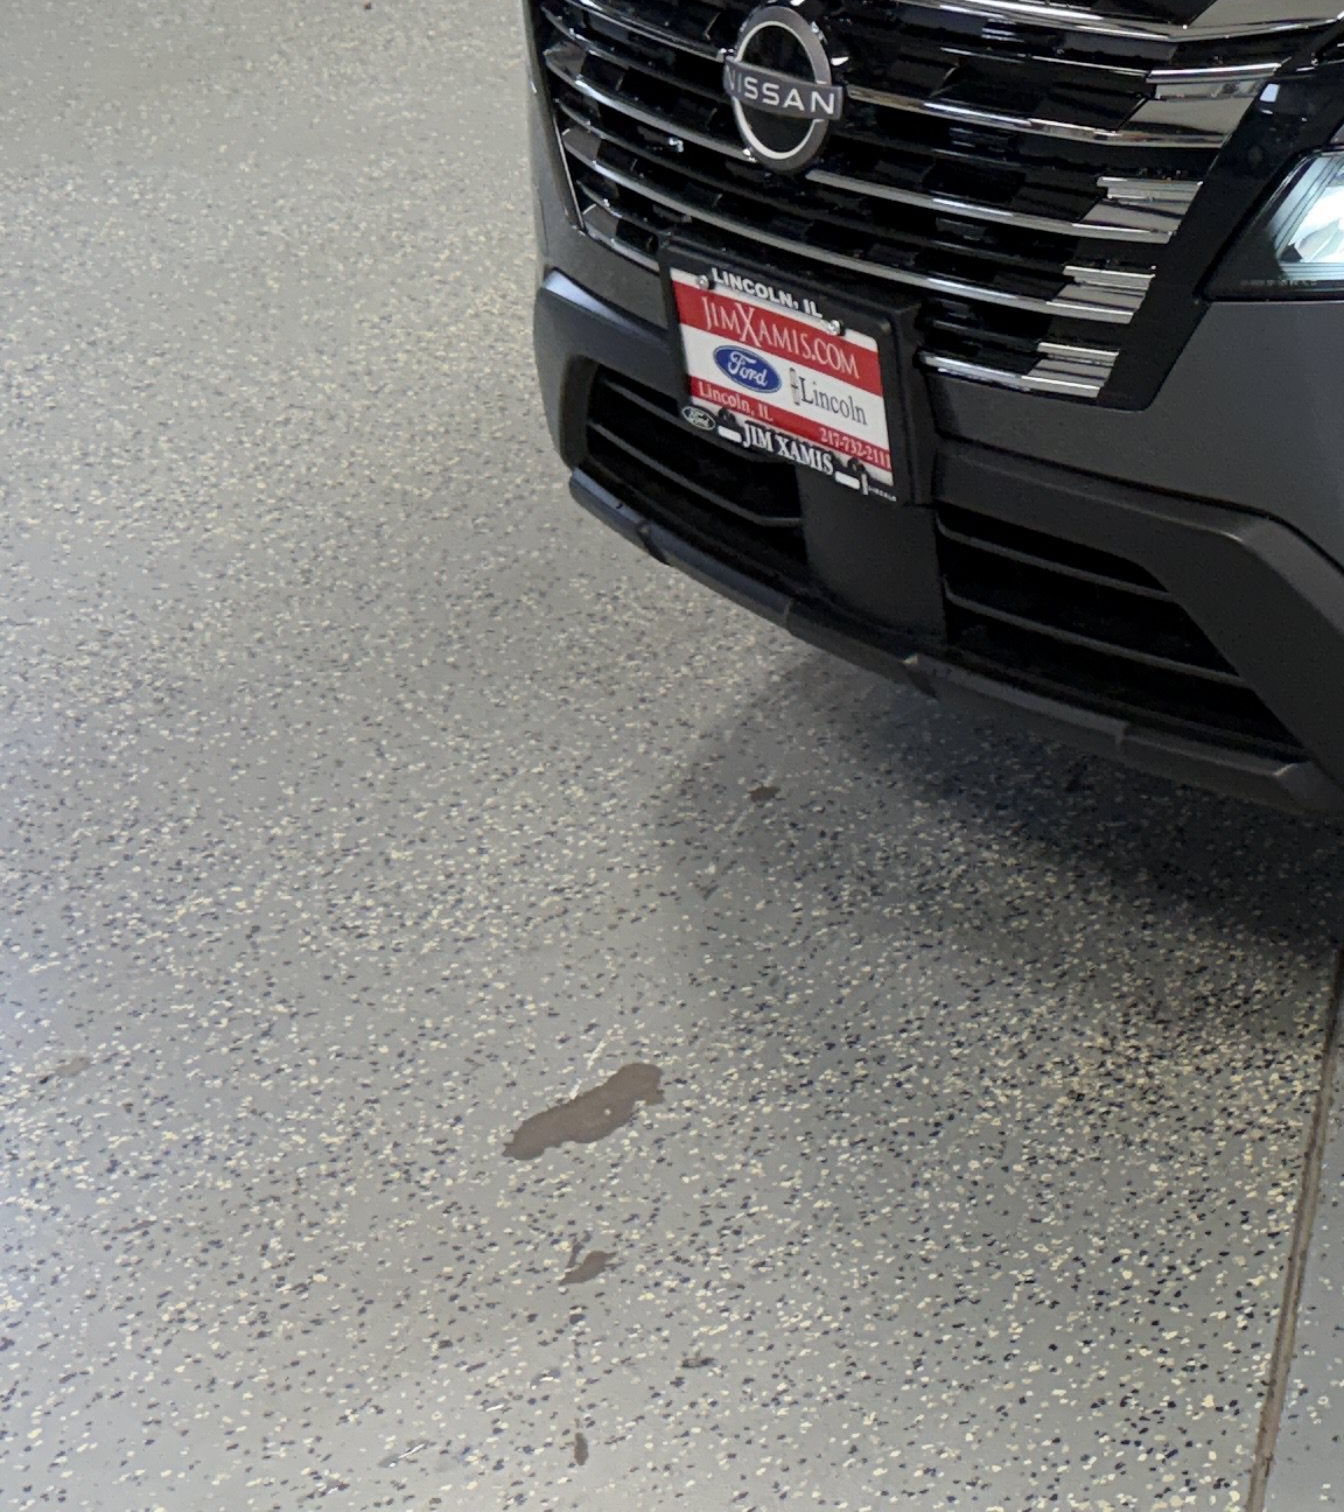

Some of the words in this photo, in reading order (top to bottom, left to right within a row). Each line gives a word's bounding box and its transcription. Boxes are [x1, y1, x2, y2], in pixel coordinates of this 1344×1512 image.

[710, 266, 800, 310] LINCOLN,
[803, 297, 823, 318] IL
[728, 350, 769, 388] Ford
[758, 401, 774, 423] IL
[799, 376, 869, 426] Lincoln
[742, 419, 774, 451] JIM
[777, 435, 835, 476] XAMIS
